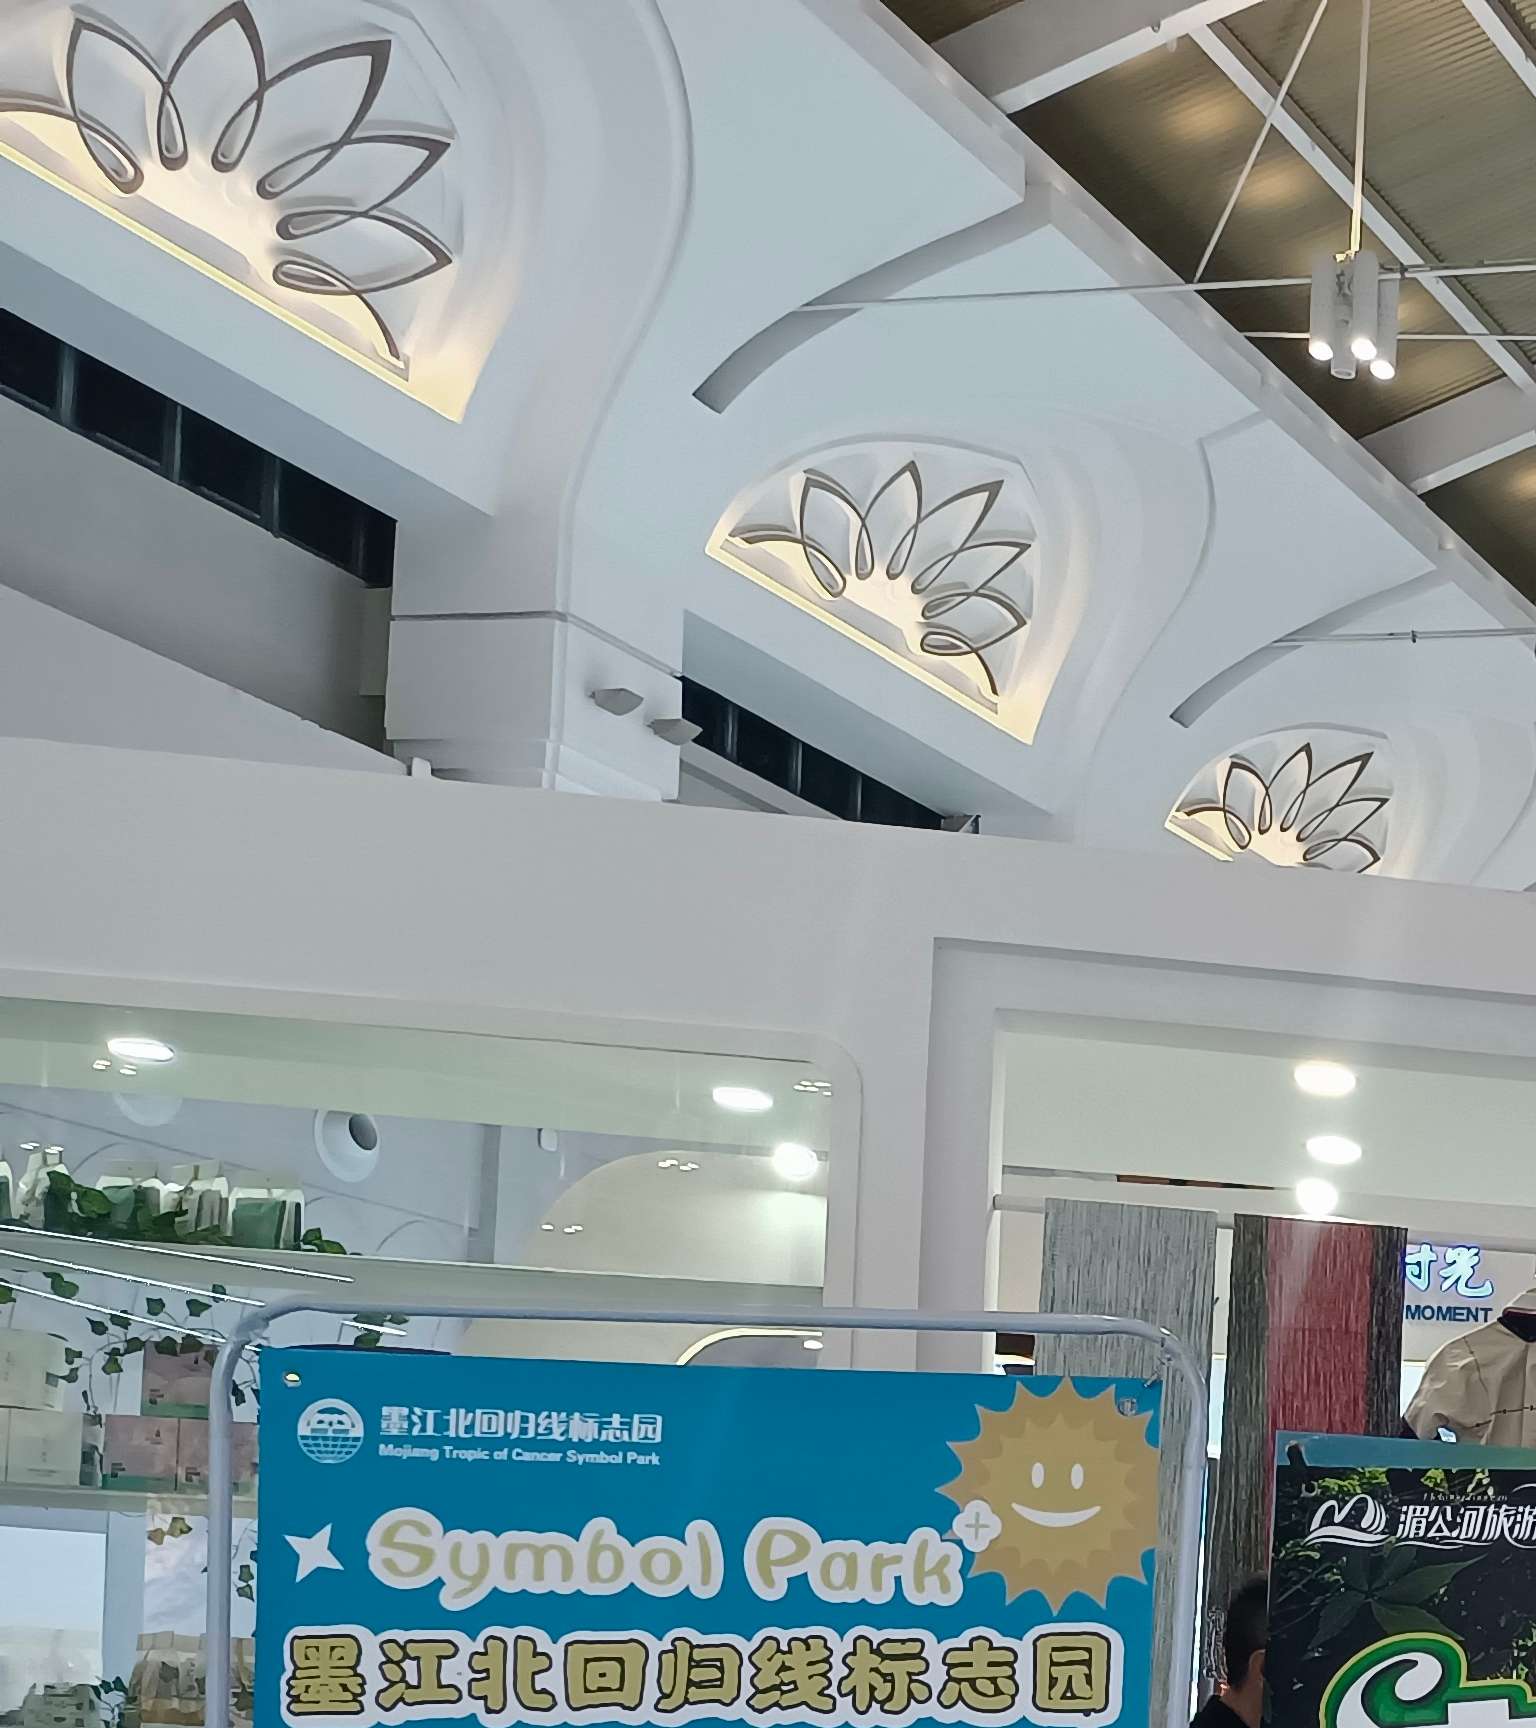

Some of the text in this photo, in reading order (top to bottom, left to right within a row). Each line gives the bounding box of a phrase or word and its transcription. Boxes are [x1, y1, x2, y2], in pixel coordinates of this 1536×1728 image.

[1405, 1305, 1493, 1322] MOMENT
[380, 1406, 662, 1443] 墨江北回归线标志园
[443, 1445, 489, 1462] Tropic
[494, 1447, 507, 1461] of
[512, 1448, 562, 1463] Cancer
[567, 1449, 622, 1465] Symbol
[628, 1450, 660, 1465] Park
[372, 1512, 960, 1605] Symbol Park
[284, 1633, 1112, 1720] 墨江北回归线标志园
